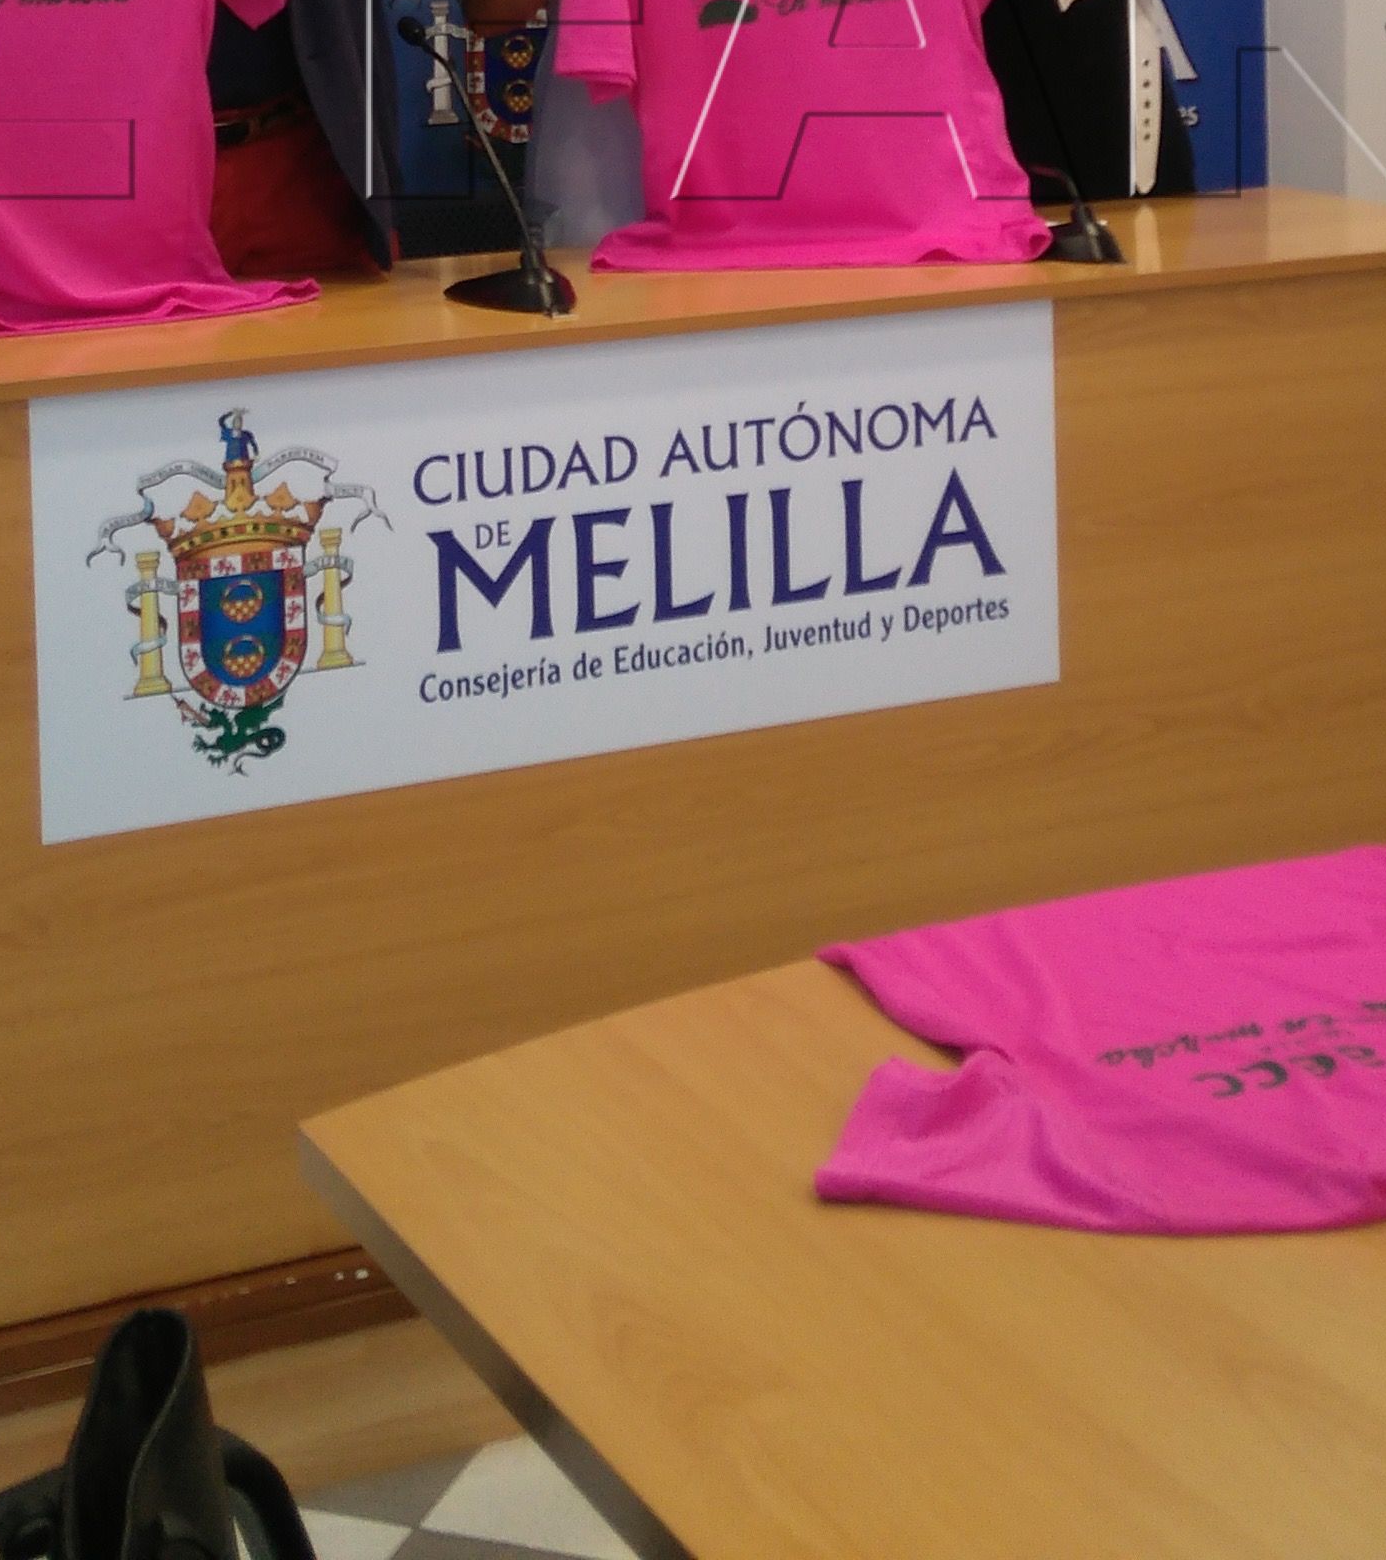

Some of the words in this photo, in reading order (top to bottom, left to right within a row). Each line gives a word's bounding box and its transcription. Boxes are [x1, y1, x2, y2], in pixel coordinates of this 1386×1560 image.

[413, 435, 639, 506] CIUDAD
[659, 395, 998, 478] AUTÓNOMA
[426, 467, 1007, 654] MELILLA
[474, 520, 512, 550] DE
[419, 657, 562, 704] Consejería
[572, 652, 604, 682] de
[614, 631, 754, 675] Educación,
[763, 611, 872, 653] Juventud
[881, 613, 894, 642] y
[903, 597, 1011, 634] Deportes
